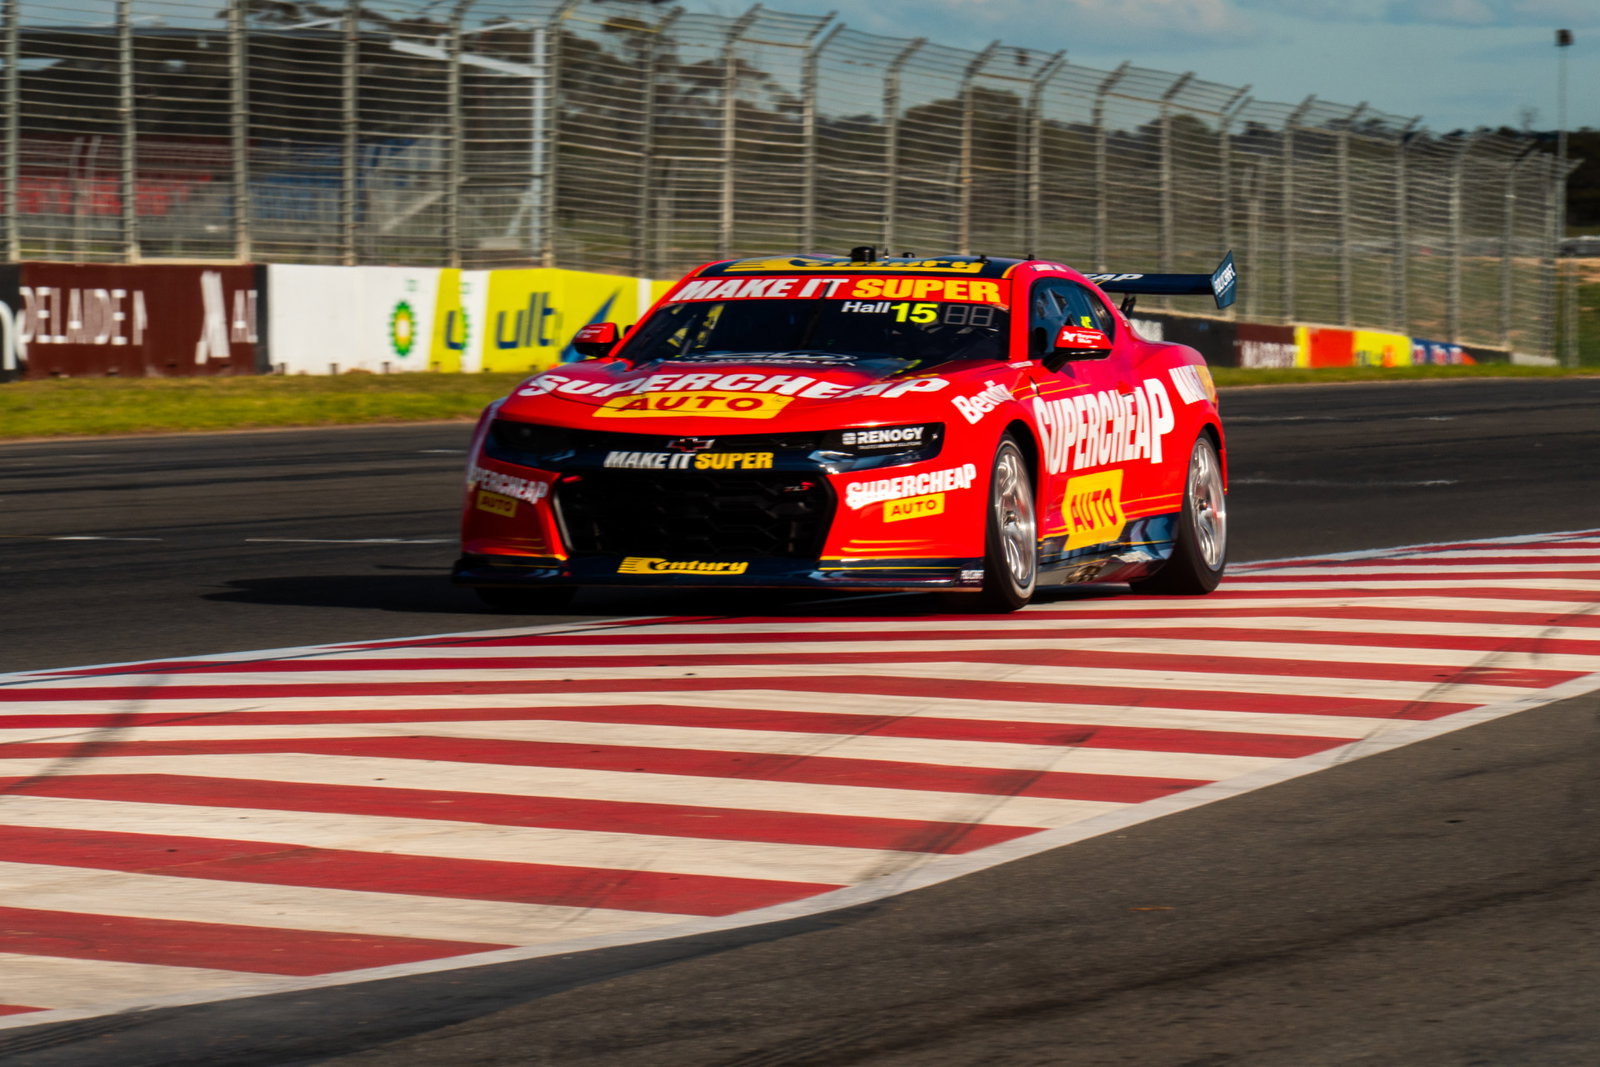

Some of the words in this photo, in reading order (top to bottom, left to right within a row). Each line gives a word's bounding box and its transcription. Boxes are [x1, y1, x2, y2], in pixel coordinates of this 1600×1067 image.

[671, 279, 800, 301] MAKE
[798, 279, 850, 298] IT
[851, 279, 1001, 302] SUPER
[841, 301, 891, 313] Hall
[891, 303, 937, 323] 15
[517, 374, 950, 399] SUPERCHEAP
[616, 396, 764, 412] AUTO
[857, 427, 924, 444] RENOGY
[1033, 378, 1175, 475] SUPERCHEAP
[603, 452, 668, 469] MAKE
[668, 452, 696, 469] IT
[694, 452, 774, 469] SUPER
[846, 463, 976, 510] SUPERCHEAP
[481, 495, 513, 512] AUTO
[890, 499, 938, 517] AUTO
[1070, 488, 1118, 532] AUTO
[648, 557, 748, 574] Century
